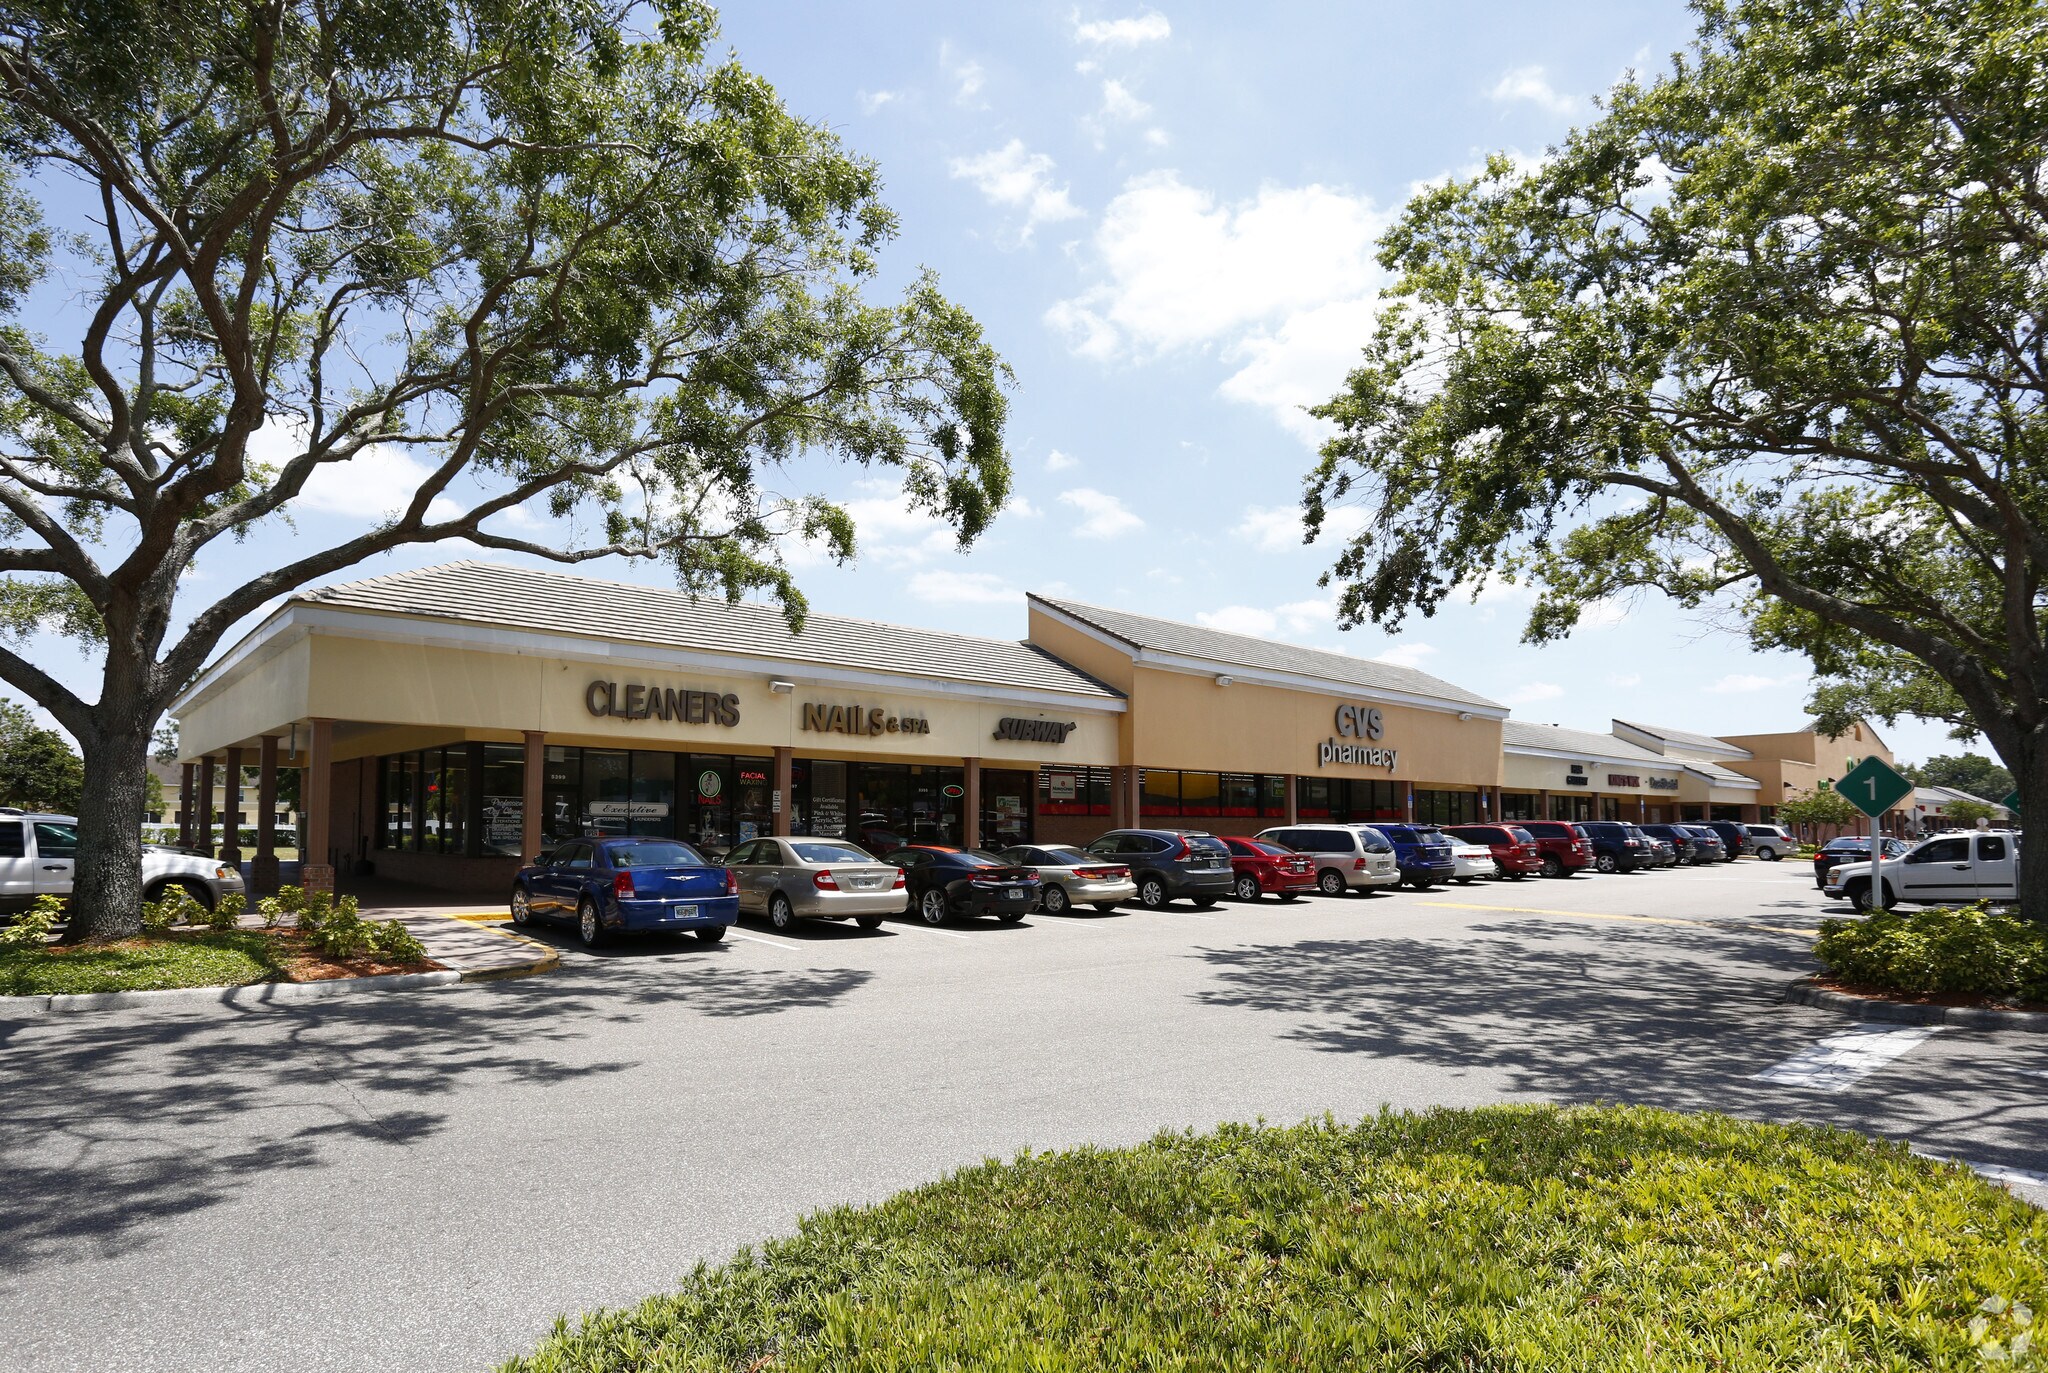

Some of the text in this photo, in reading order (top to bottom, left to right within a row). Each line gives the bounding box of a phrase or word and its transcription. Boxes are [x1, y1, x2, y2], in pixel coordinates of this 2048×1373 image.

[586, 680, 741, 728] CLEANERS
[802, 702, 930, 736] NAILS & SPA
[993, 718, 1077, 744] SUBWAY
[1335, 704, 1384, 740] CVS
[1318, 737, 1399, 774] pharmacy
[740, 772, 766, 780] FACIAL
[1863, 776, 1876, 801] 1
[602, 804, 657, 814] Executive
[697, 794, 721, 806] NAILS
